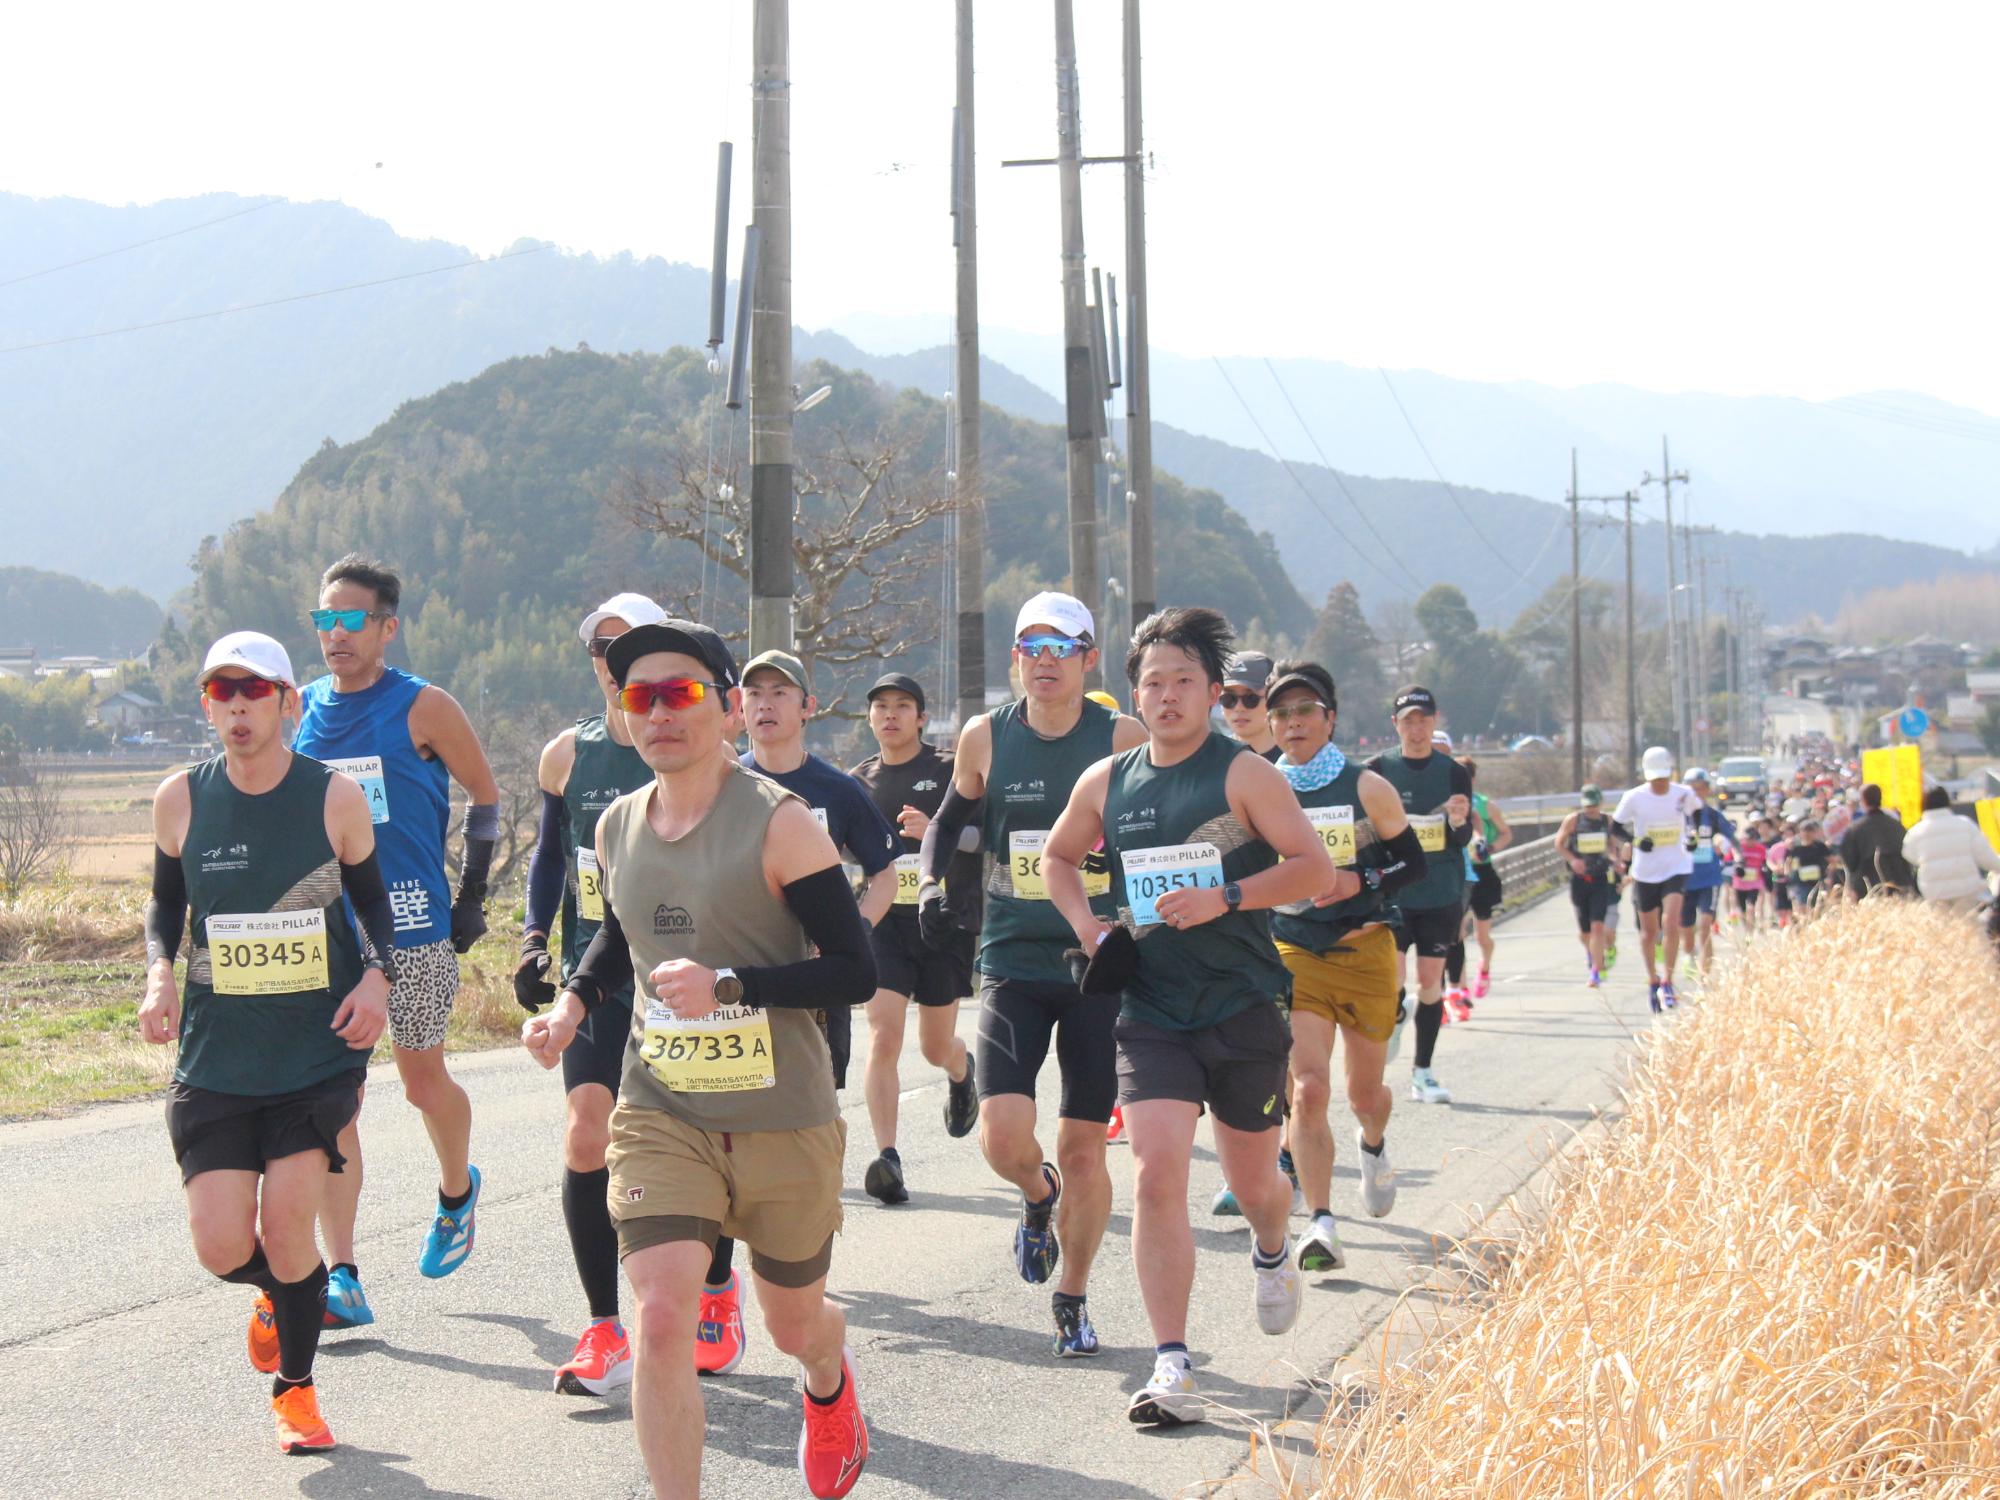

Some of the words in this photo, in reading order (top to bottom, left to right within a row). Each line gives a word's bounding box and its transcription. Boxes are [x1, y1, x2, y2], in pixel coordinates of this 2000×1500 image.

[347, 763, 378, 774] PILLAR
[372, 787, 383, 802] A
[1321, 811, 1349, 820] PILLAR
[1342, 833, 1352, 846] A
[1178, 848, 1215, 861] PILLAR
[392, 879, 421, 890] KABE
[1132, 872, 1199, 900] 10351
[1209, 875, 1219, 889] A
[388, 888, 433, 932] 壁
[246, 921, 280, 931] 株式会社
[281, 916, 321, 930] PILLAR
[218, 941, 306, 968] 30345
[311, 945, 323, 964] A
[713, 1007, 761, 1021] PILLAR
[648, 1034, 744, 1061] 36733
[752, 1037, 767, 1058] A
[685, 1073, 764, 1085] TAMBASASAYAMA
[702, 1082, 744, 1090] MARATHON
